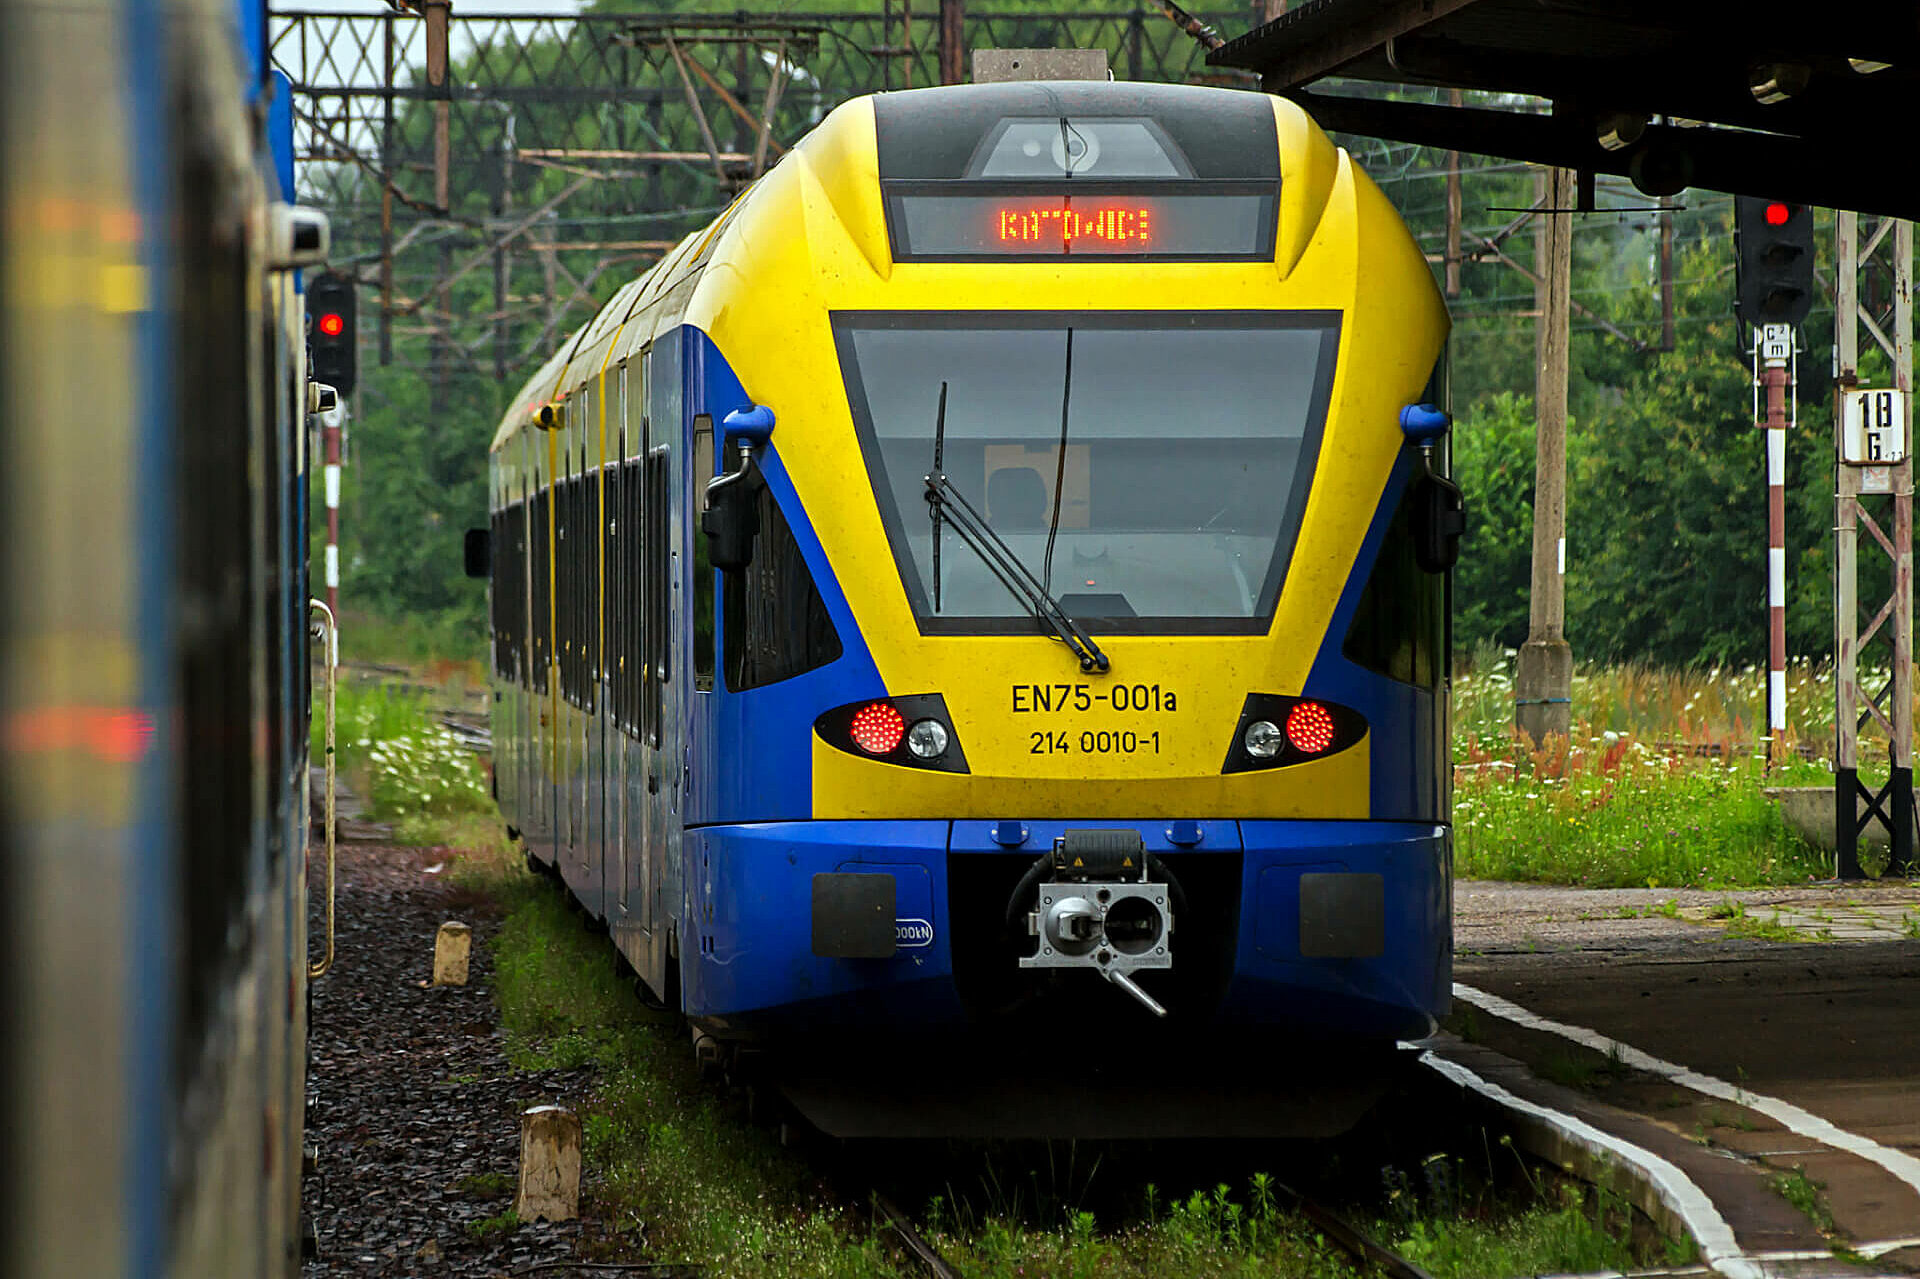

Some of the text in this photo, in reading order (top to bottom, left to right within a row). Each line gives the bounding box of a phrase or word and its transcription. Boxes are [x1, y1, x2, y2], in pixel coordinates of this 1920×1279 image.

[1858, 392, 1892, 428] 18
[1012, 684, 1177, 713] EN75-001a
[1030, 731, 1160, 754] 214 0010-1
